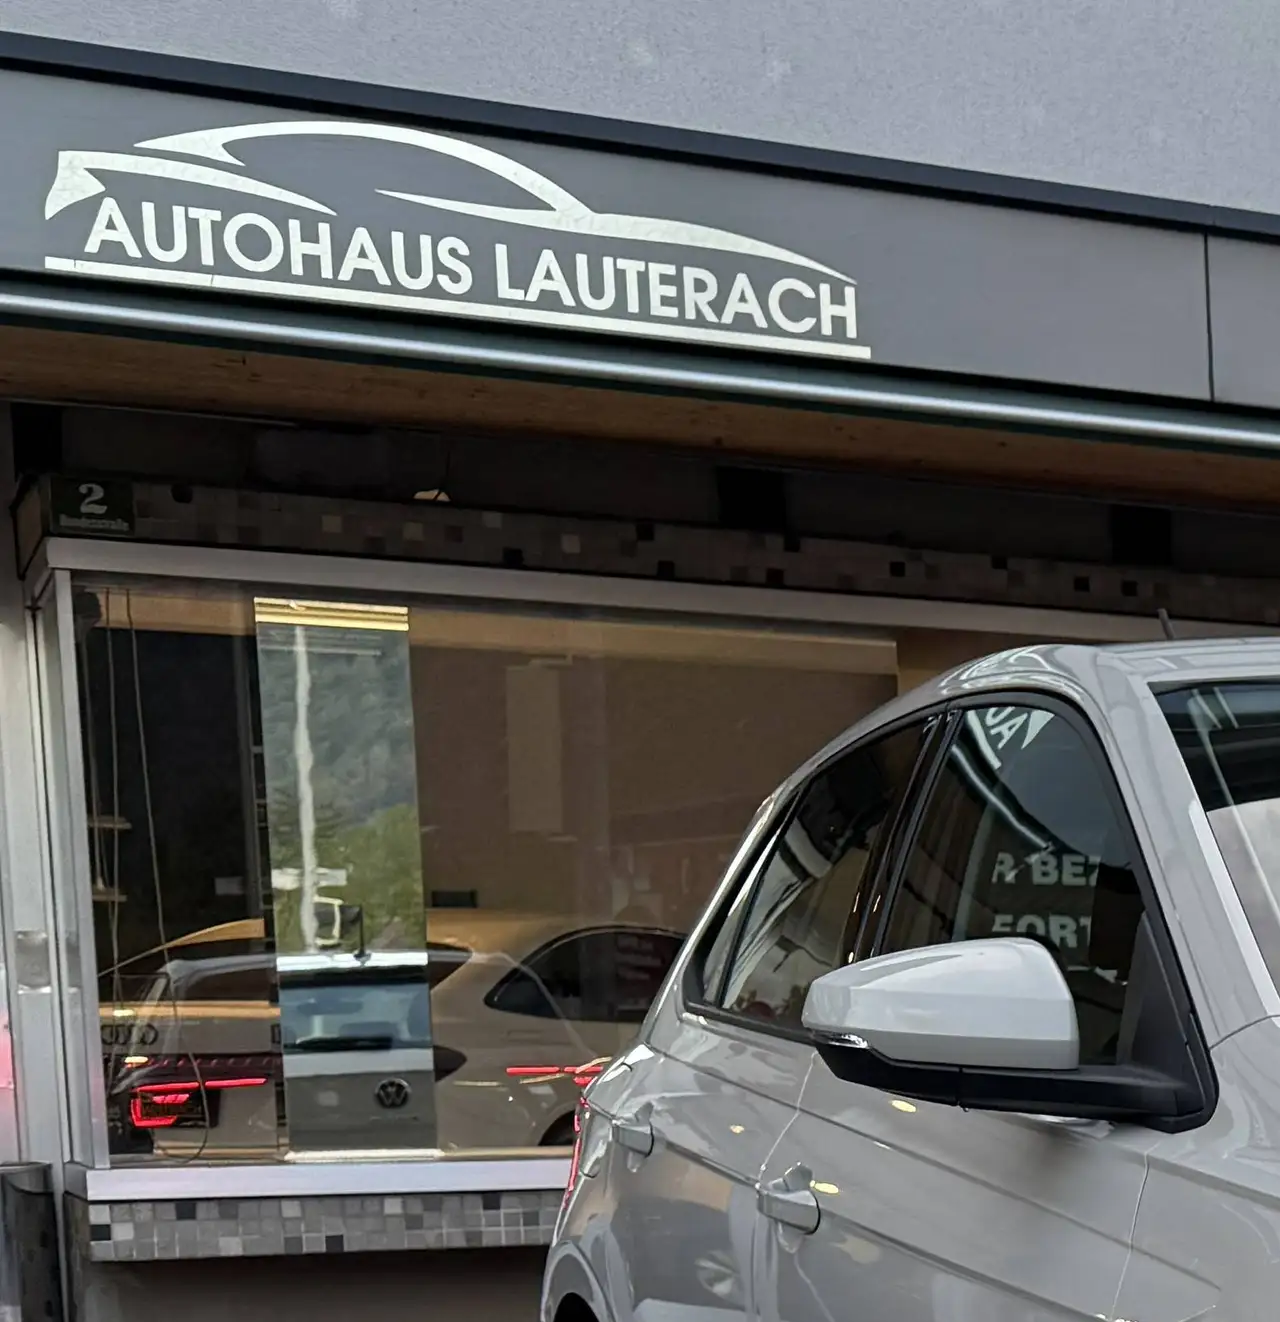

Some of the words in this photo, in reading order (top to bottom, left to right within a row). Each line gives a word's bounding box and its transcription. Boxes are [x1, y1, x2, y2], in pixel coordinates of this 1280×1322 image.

[84, 197, 473, 295] AUTOHAUS
[494, 242, 859, 339] LAUTERACH
[79, 483, 108, 514] 2
